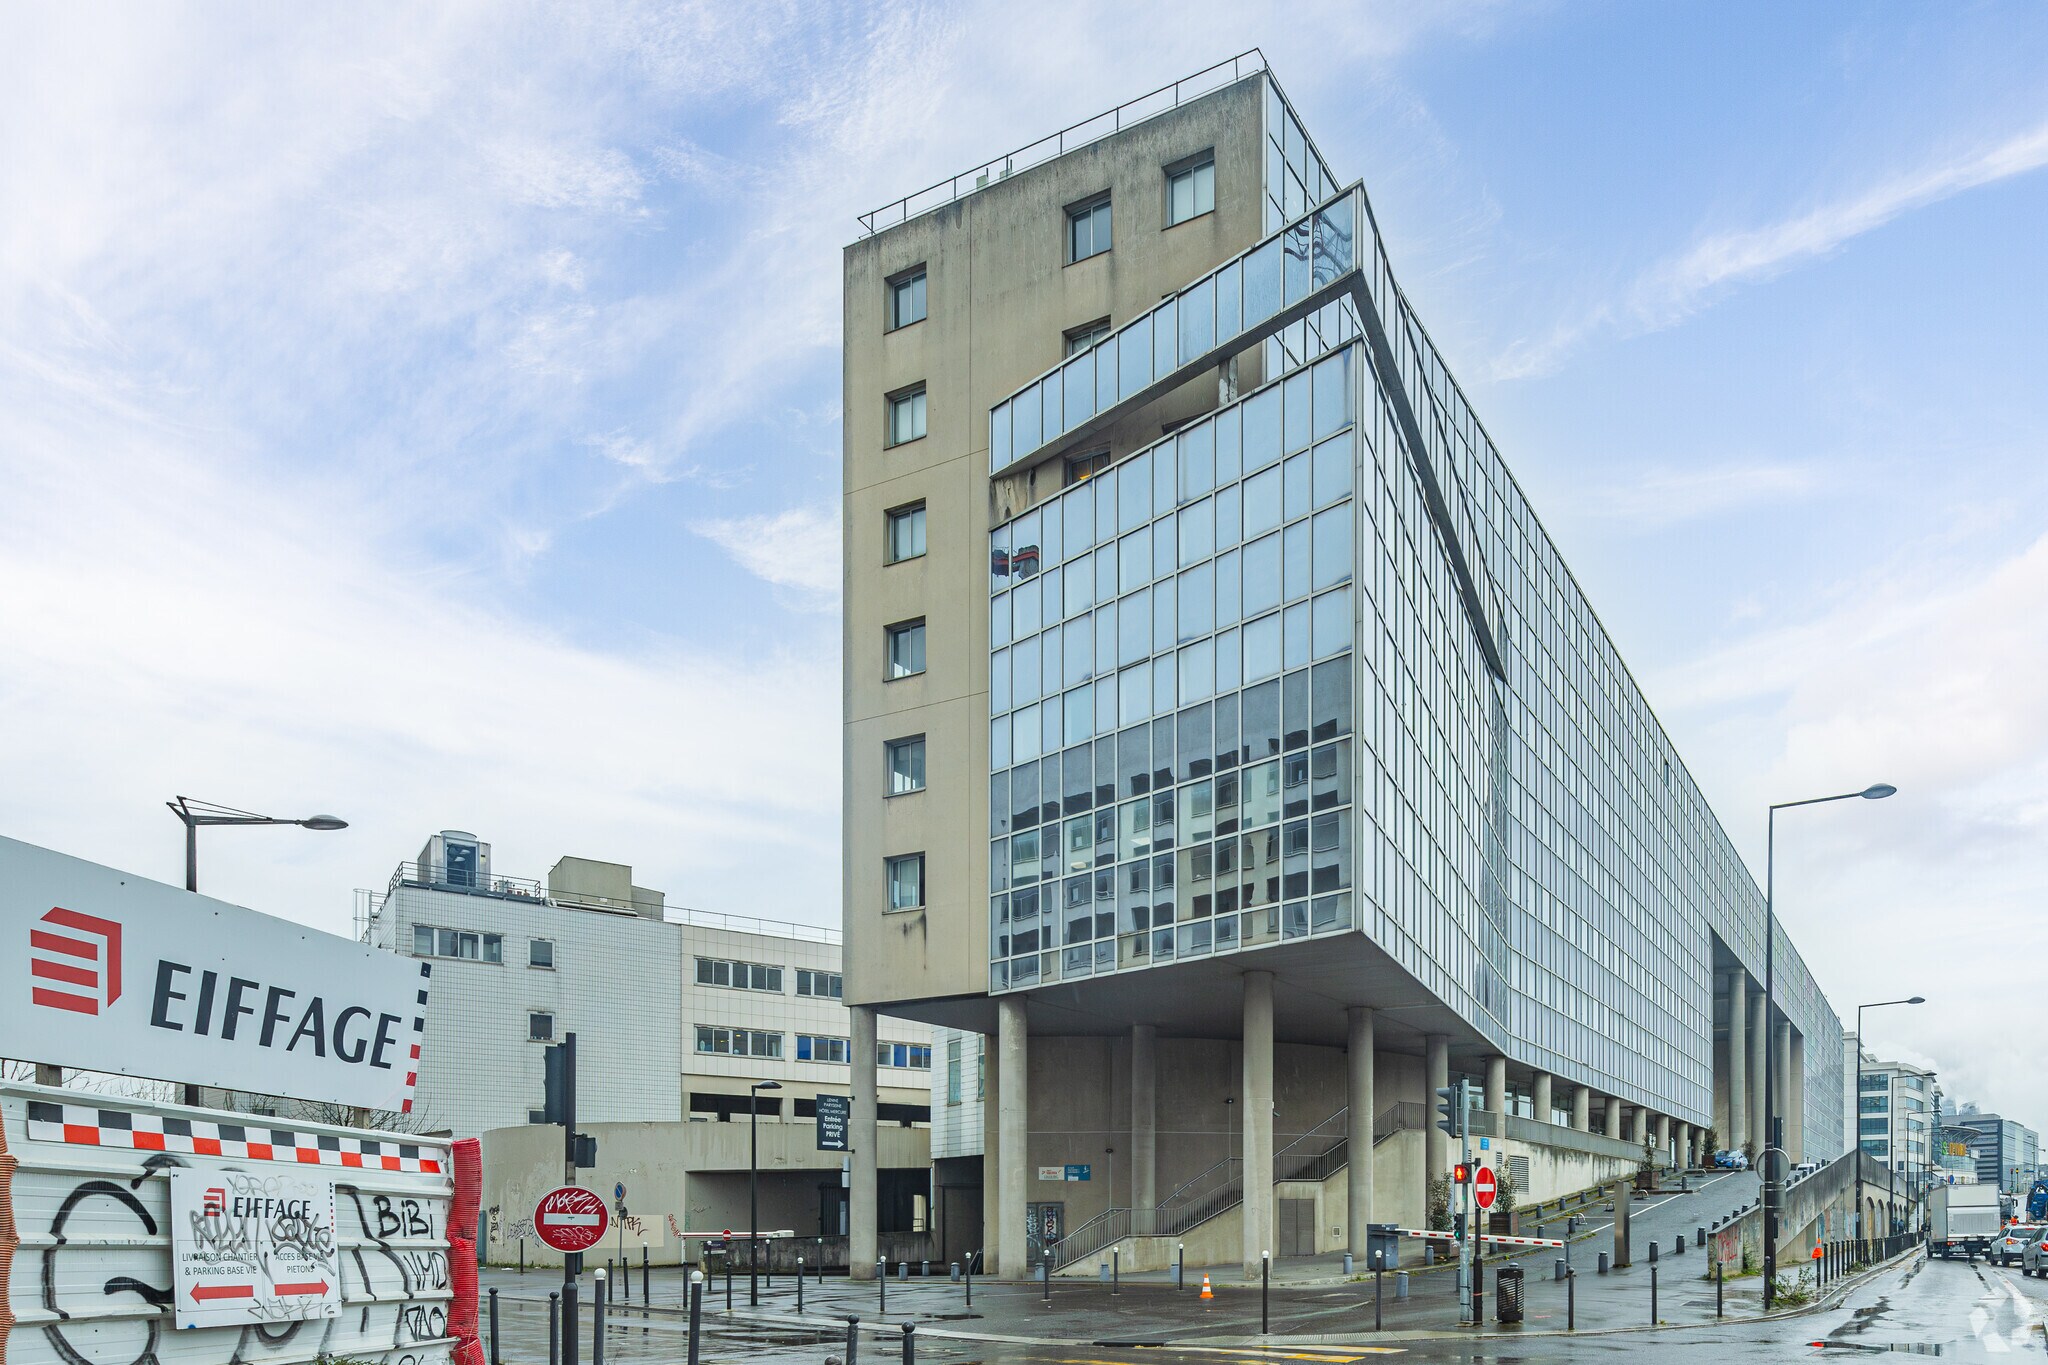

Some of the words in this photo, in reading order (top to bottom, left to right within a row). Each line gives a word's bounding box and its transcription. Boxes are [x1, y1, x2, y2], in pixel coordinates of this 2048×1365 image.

[150, 959, 402, 1070] EIFFAGE
[824, 1115, 842, 1123] Entrée
[823, 1123, 843, 1131] Parking
[825, 1130, 841, 1138] PRIVÉ
[233, 1196, 311, 1219] EIFFAGE
[182, 1252, 221, 1262] LIVRAISON
[223, 1252, 258, 1262] CHANTIER
[275, 1252, 295, 1261] ACCES
[184, 1266, 191, 1276] &
[193, 1266, 225, 1276] PARKING
[226, 1265, 244, 1275] BASE
[245, 1265, 257, 1275] VIE
[286, 1264, 314, 1274] PIETONS
